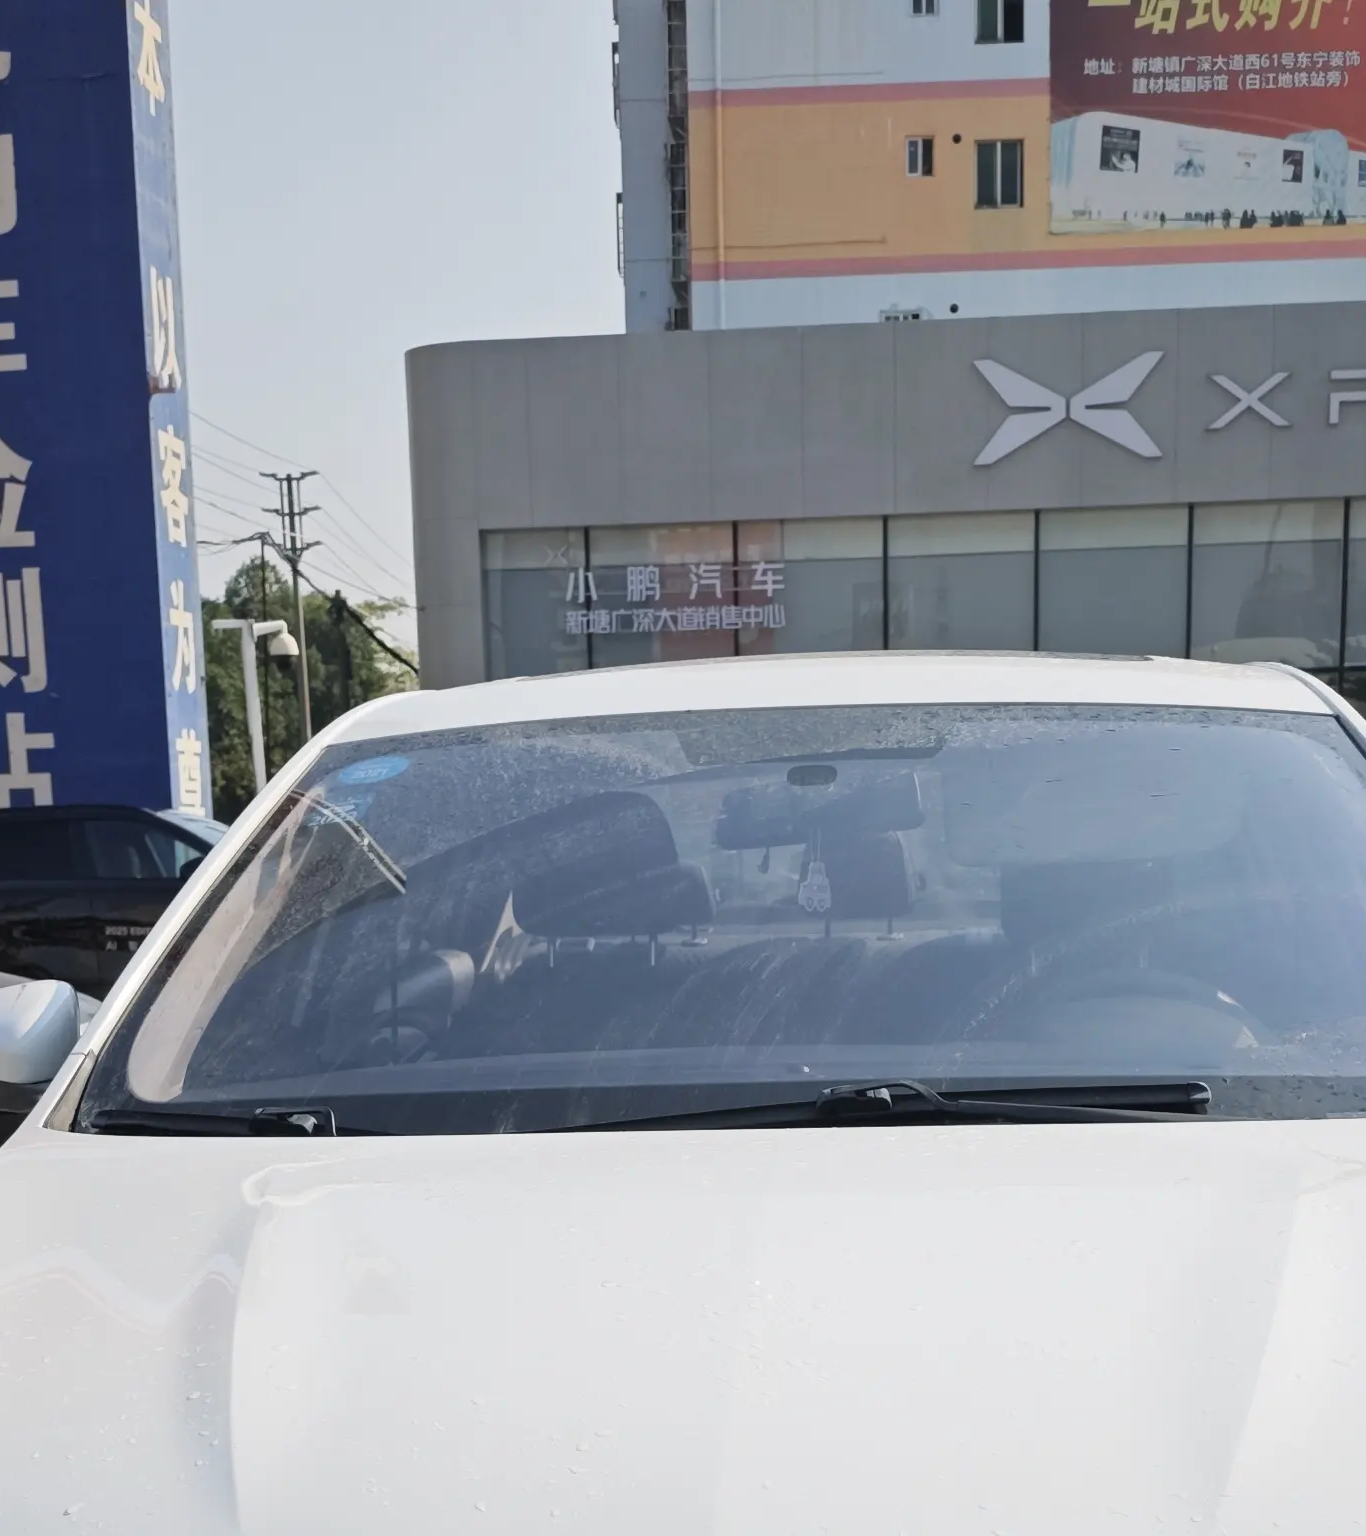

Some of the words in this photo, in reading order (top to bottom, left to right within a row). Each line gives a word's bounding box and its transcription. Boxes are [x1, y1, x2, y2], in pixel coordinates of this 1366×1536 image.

[566, 562, 785, 604] 小鹏汽车
[566, 603, 785, 635] 新塘广深大道销售中心
